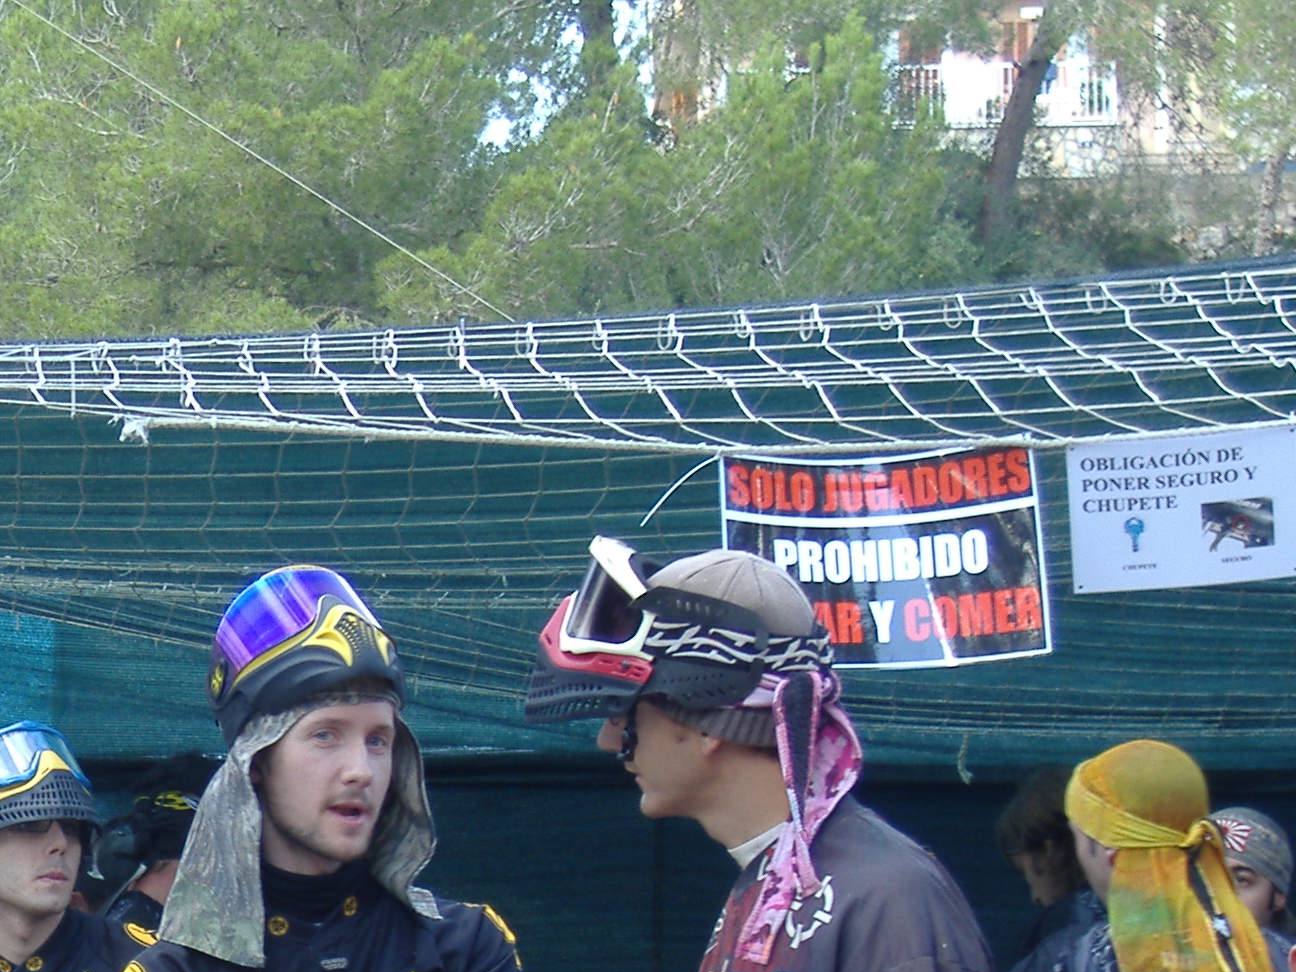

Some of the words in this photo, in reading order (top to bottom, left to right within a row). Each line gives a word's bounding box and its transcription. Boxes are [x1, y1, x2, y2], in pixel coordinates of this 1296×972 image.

[822, 447, 1031, 513] JUGADORES
[1080, 448, 1210, 472] OBLIGACIÓN
[1217, 446, 1245, 464] DE
[1082, 477, 1150, 493] PONER
[1154, 469, 1238, 490] SEGURO
[1243, 465, 1258, 481] Y
[1082, 494, 1179, 514] CHUPETE
[773, 528, 990, 584] PROHIBIDO
[868, 600, 895, 644] Y
[903, 586, 1042, 642] COMER
